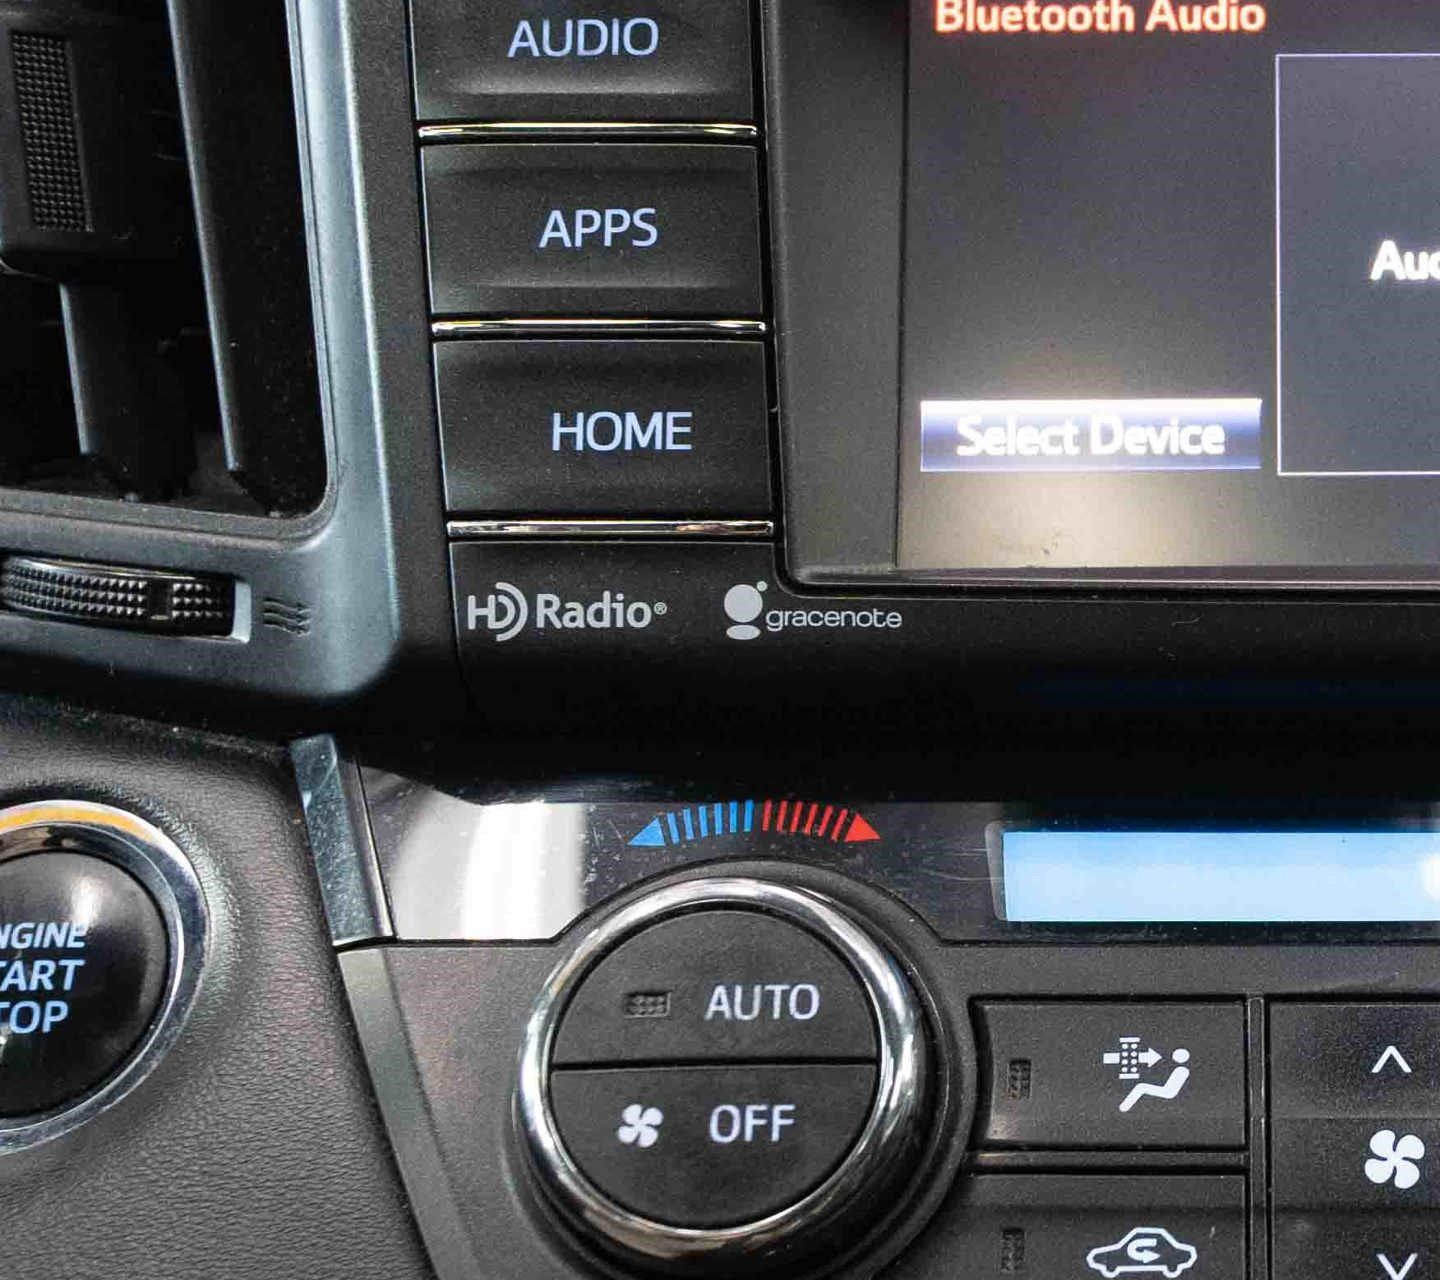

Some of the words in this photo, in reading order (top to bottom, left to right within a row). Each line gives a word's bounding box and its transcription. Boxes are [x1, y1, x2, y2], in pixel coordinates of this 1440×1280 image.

[506, 17, 660, 58] AUDIO
[538, 207, 659, 250] APPS
[550, 411, 694, 453] HOME
[956, 415, 1081, 456] Select
[1090, 414, 1226, 455] Device
[766, 608, 902, 632] gracenote
[705, 983, 821, 1021] AUTO
[708, 1103, 796, 1144] OFF
